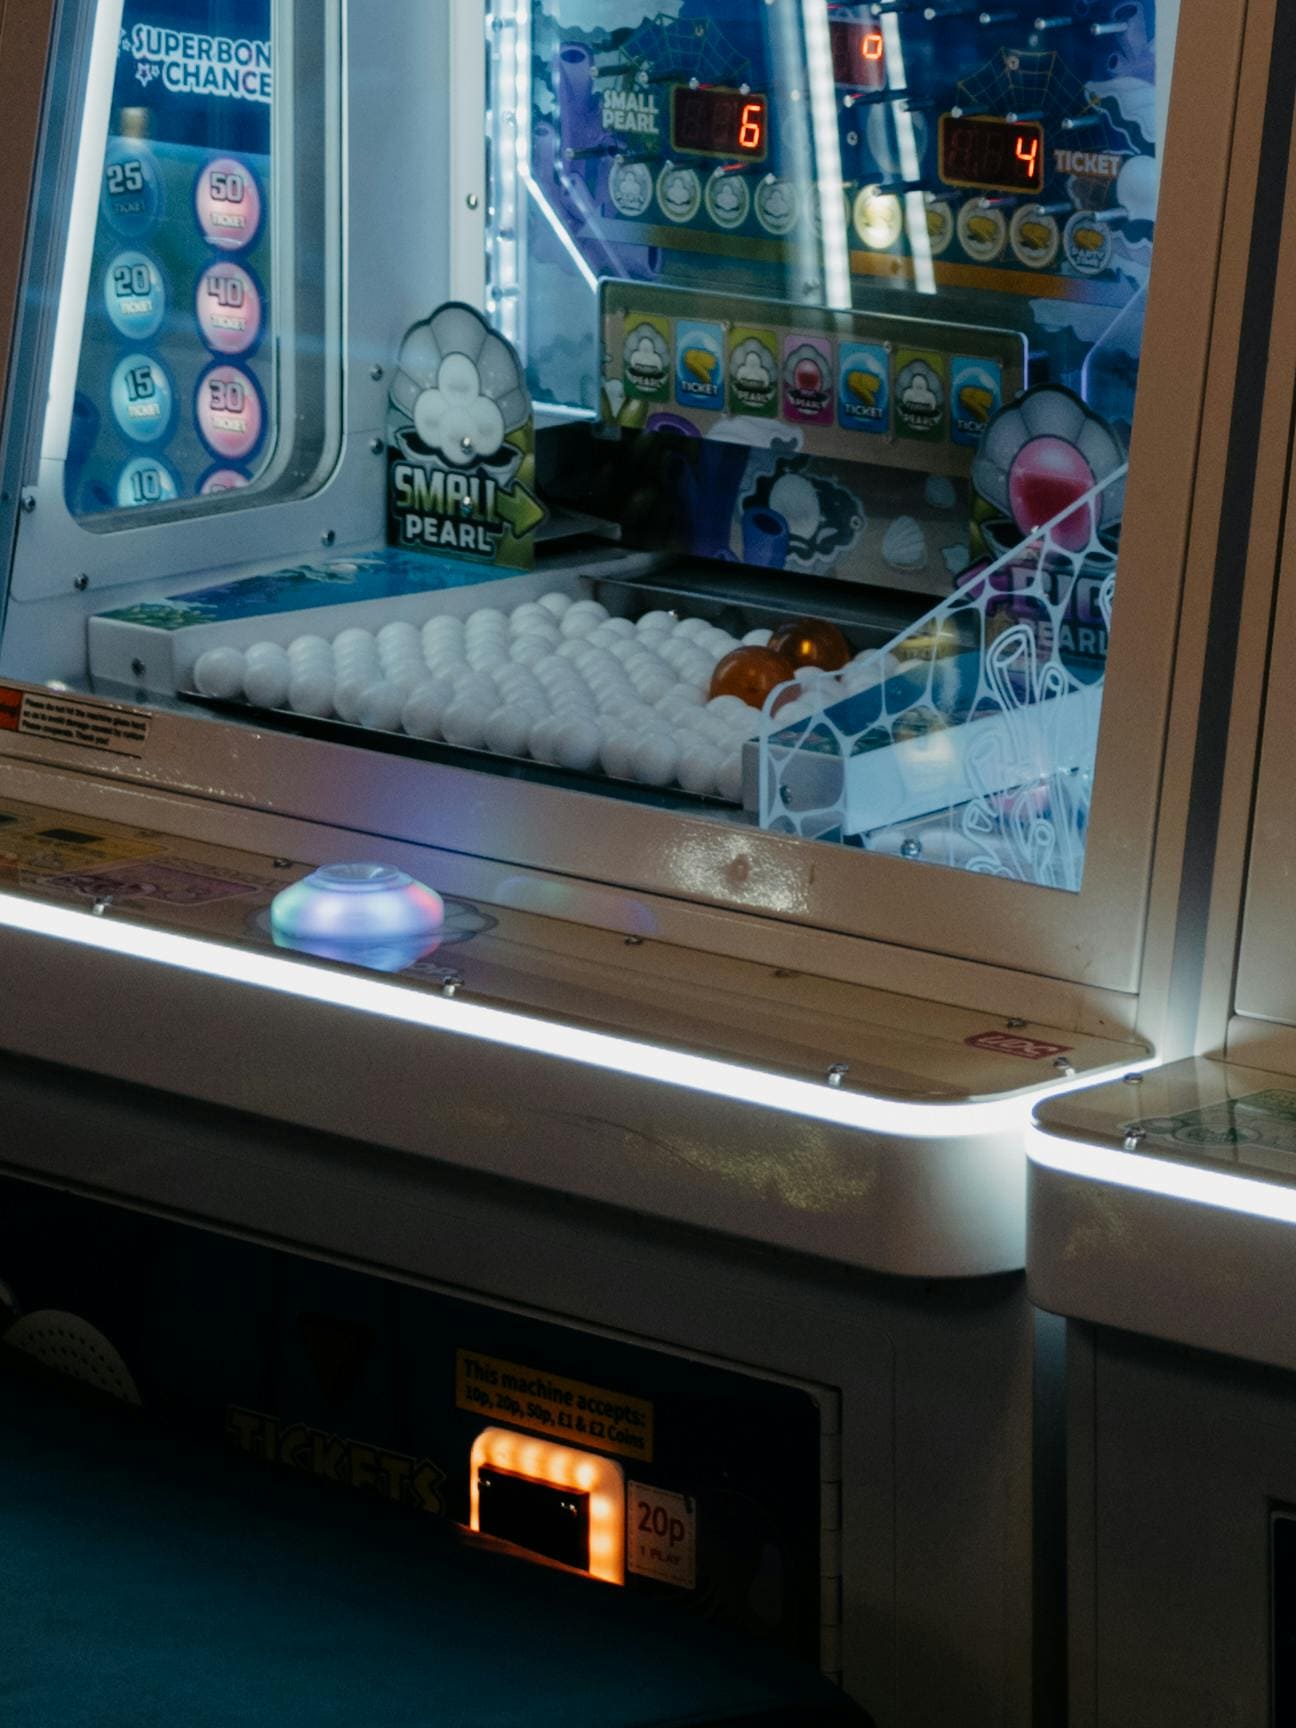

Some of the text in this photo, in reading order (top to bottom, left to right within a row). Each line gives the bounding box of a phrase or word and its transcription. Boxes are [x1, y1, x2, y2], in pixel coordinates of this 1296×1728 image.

[861, 34, 882, 61] 0
[165, 61, 272, 97] CHANCE
[603, 90, 660, 114] SMALL
[602, 109, 660, 134] PEARL
[738, 104, 761, 148] 6
[1016, 135, 1039, 179] 4
[1053, 149, 1122, 177] TICKET
[107, 160, 144, 194] 25
[209, 171, 245, 203] 50
[114, 263, 151, 298] 20
[208, 275, 245, 308] 40
[124, 366, 155, 402] 15
[209, 379, 245, 414] 30
[680, 379, 720, 396] TICKET
[736, 390, 772, 404] PEARL
[844, 402, 884, 419] TICKET
[131, 468, 160, 504] 10
[395, 463, 498, 525] SMALL
[406, 514, 492, 553] PEARL
[463, 1358, 646, 1428] This machine accepts:
[464, 1385, 646, 1451] 10p, 20p, 50p, £1 & £2 Coins
[226, 1406, 446, 1518] TICKETS
[637, 1500, 686, 1548] 20p
[649, 1548, 682, 1566] PLAY
